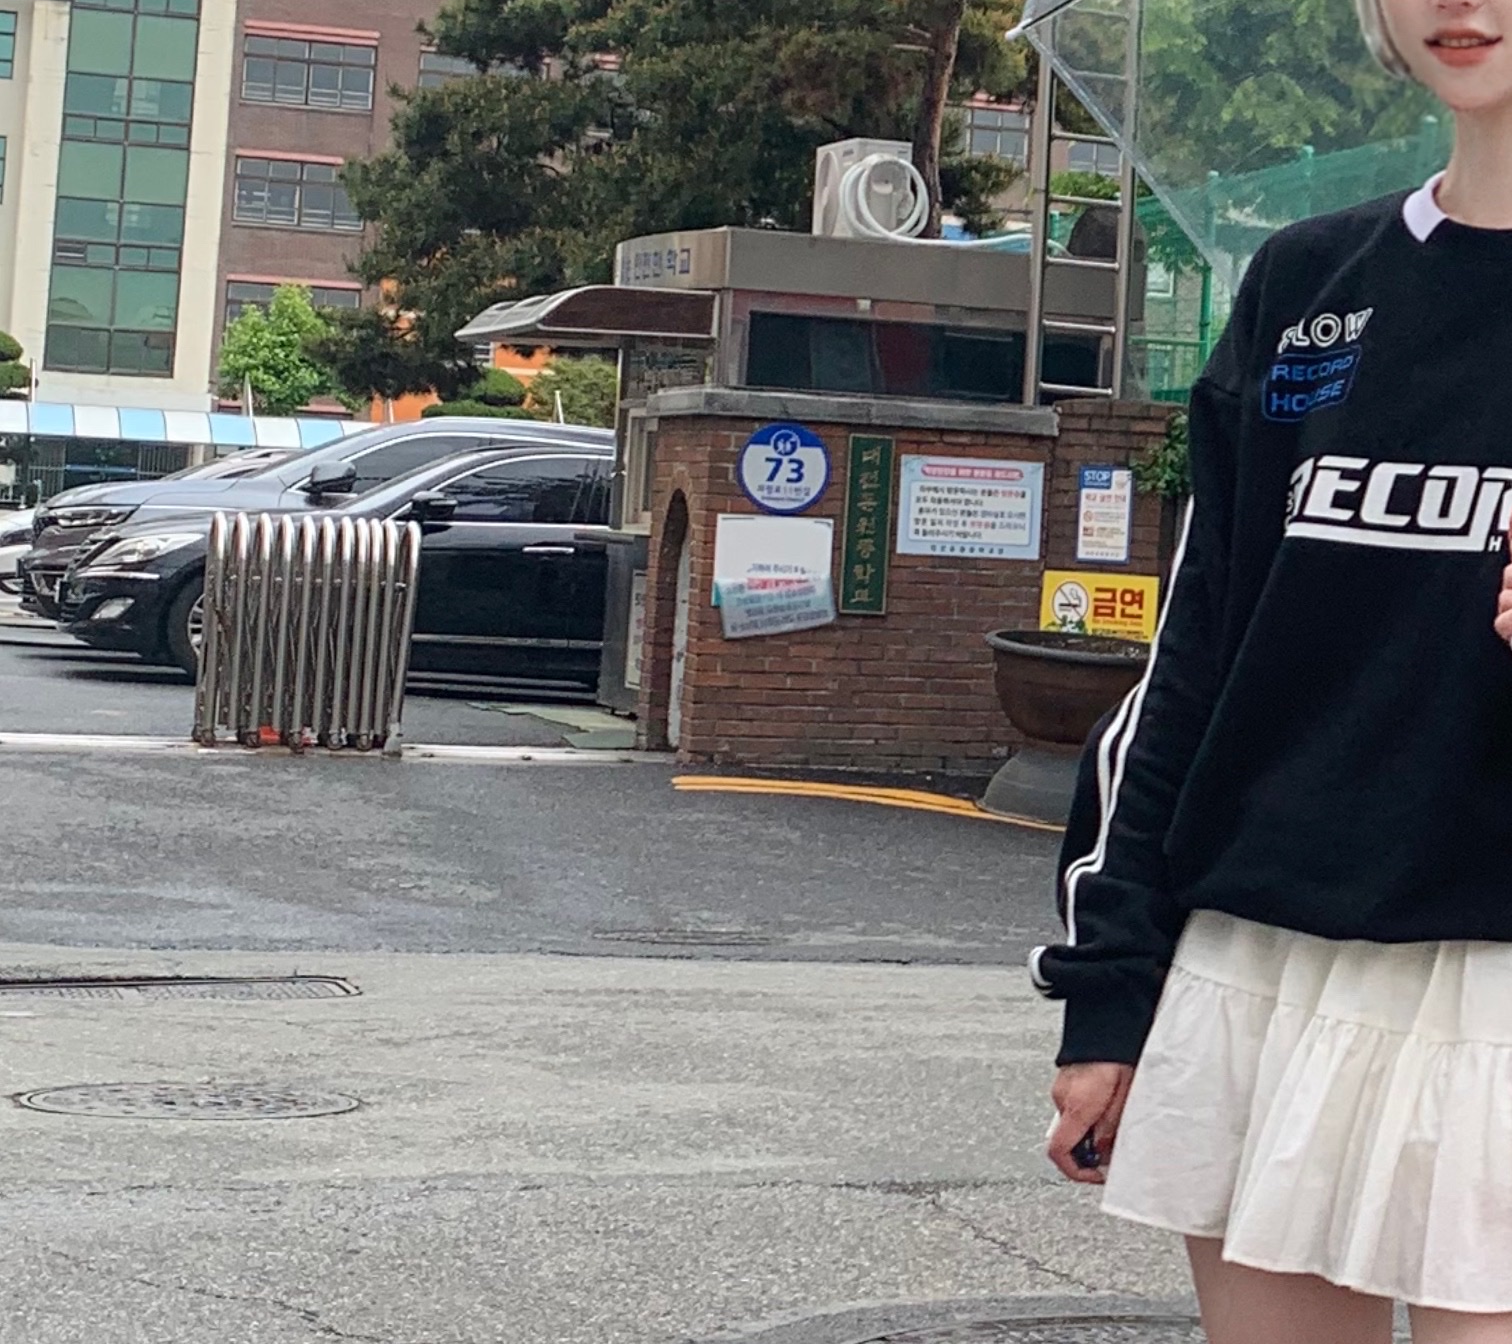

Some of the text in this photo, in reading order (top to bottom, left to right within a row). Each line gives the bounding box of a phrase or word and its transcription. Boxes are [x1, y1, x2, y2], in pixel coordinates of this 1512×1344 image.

[765, 457, 804, 483] 73
[1084, 469, 1111, 482] STOP
[1093, 586, 1145, 618] 금연
